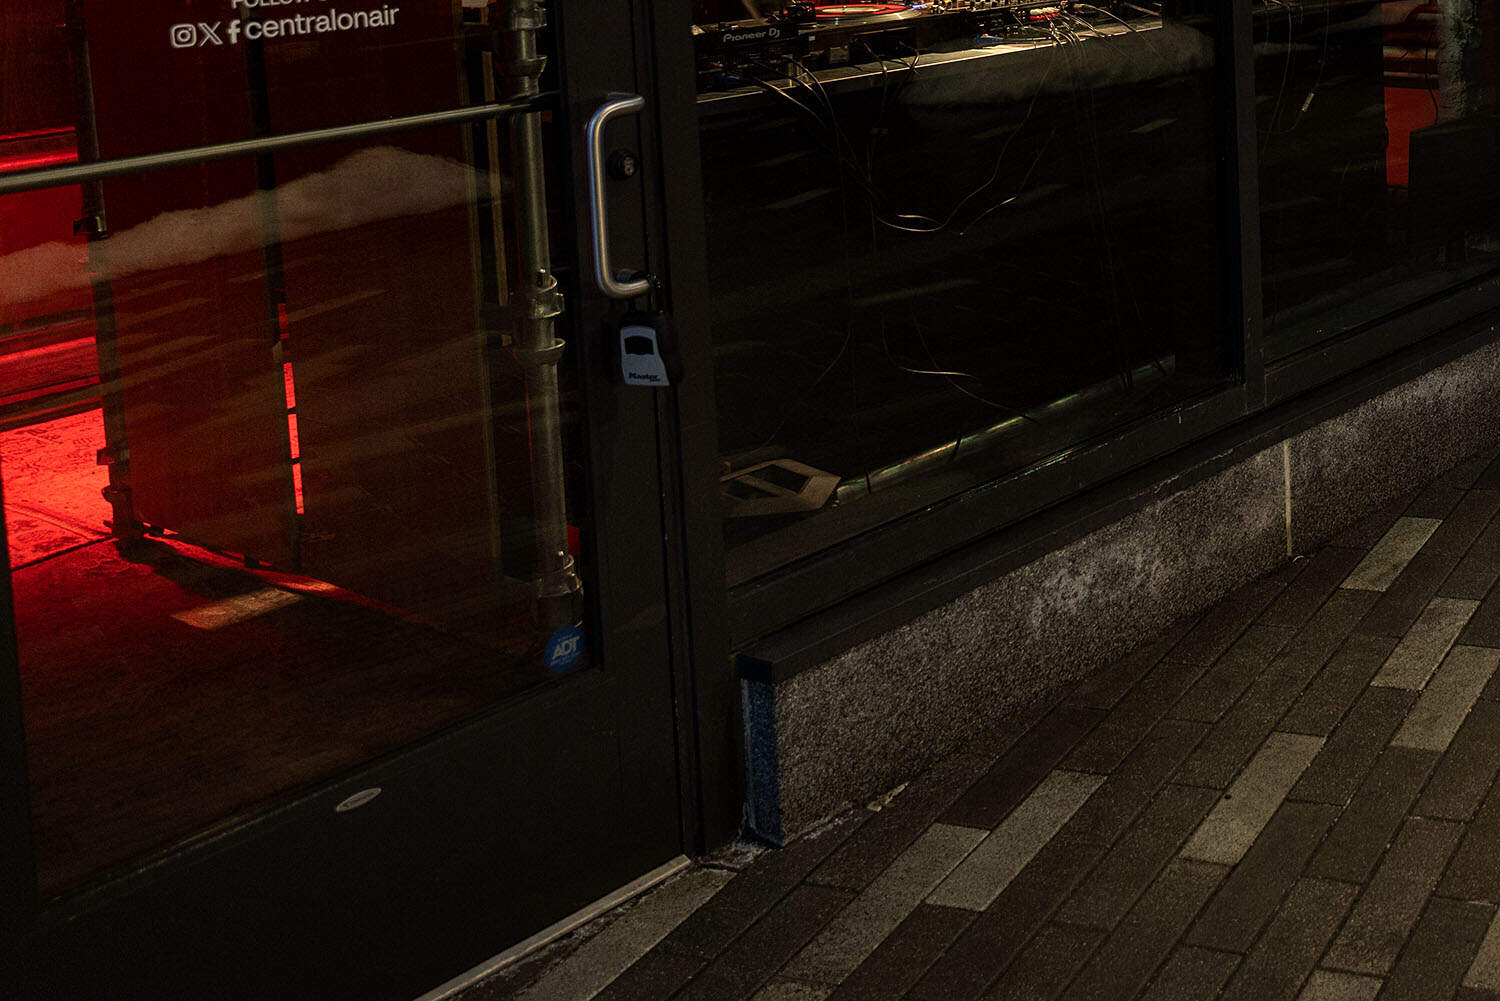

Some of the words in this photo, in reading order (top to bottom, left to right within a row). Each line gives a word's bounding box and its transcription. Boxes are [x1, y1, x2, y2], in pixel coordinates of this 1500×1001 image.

[244, 5, 400, 40] centralonair
[723, 31, 767, 43] Pioneer
[551, 636, 580, 660] ADT
